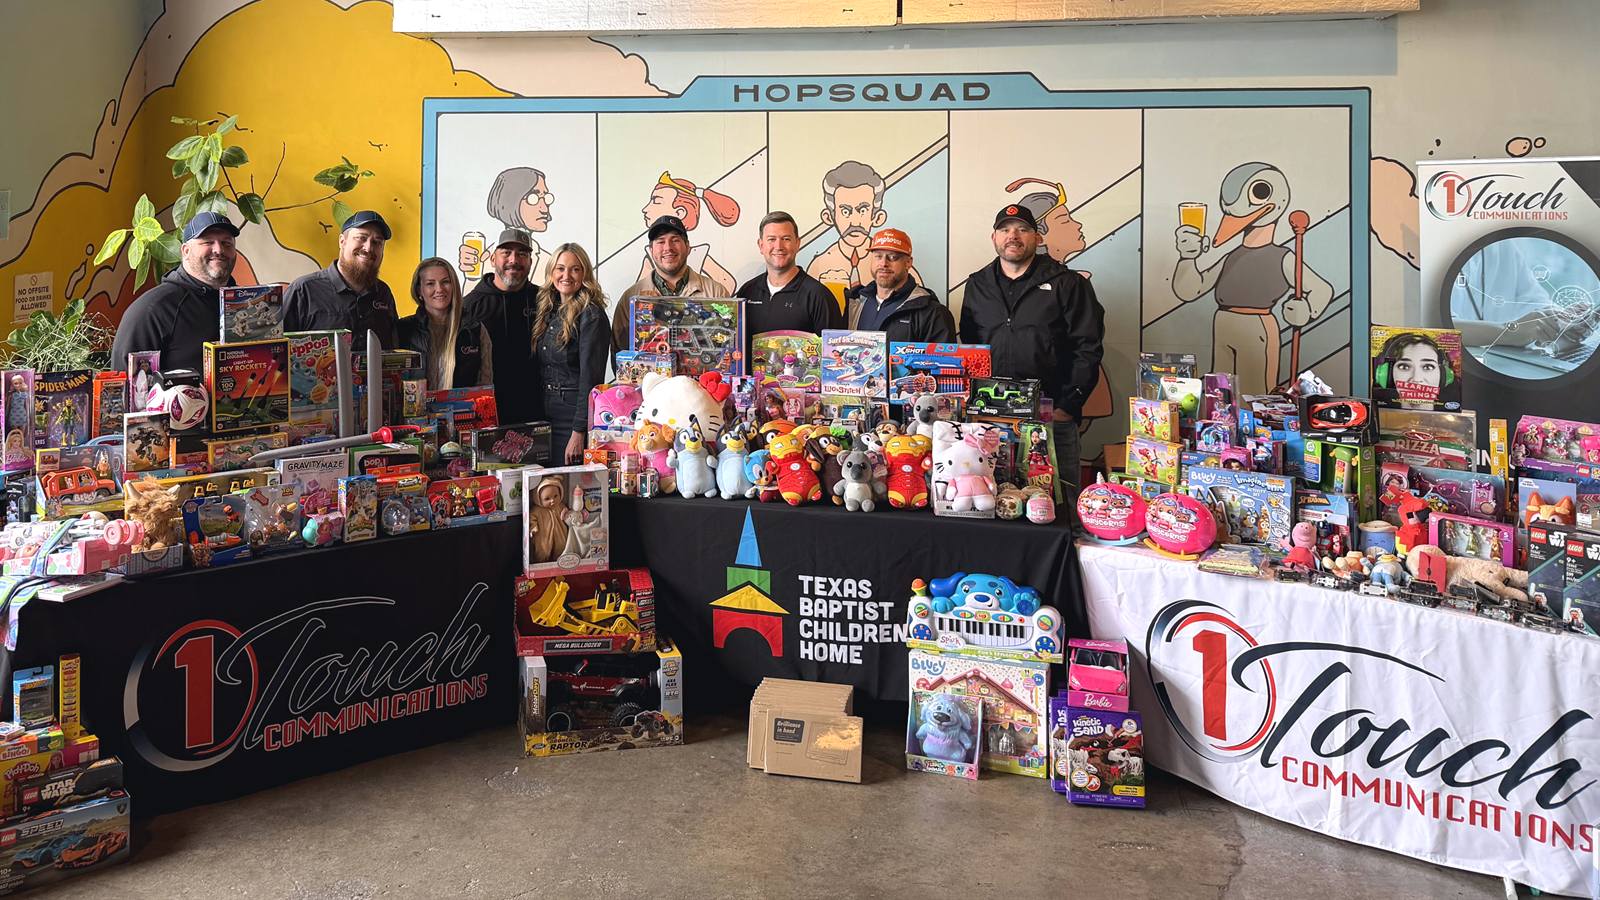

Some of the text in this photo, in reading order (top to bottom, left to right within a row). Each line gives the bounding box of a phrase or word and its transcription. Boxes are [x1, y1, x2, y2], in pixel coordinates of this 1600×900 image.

[733, 82, 991, 102] HOPSQUAD
[1443, 174, 1568, 217] 1 Touch
[1473, 211, 1568, 221] COMMUNICATIONS
[28, 286, 49, 294] OFFSITE
[237, 289, 257, 299] Disney
[20, 301, 47, 311] ALLOWED
[235, 362, 267, 371] ROCKETS
[34, 374, 89, 392] SPIDER-MAN
[1396, 381, 1440, 394] HEARING
[1400, 391, 1437, 399] THINGS
[982, 407, 998, 415] Jeep
[1394, 439, 1440, 454] PIZZA
[287, 460, 344, 471] GRAVITY MAZE
[1531, 532, 1546, 540] LEGO
[1567, 545, 1583, 554] LEGO
[798, 574, 873, 599] TEXAS
[799, 597, 894, 621] BAPTIST
[799, 619, 908, 643] CHILDREN
[800, 640, 863, 665] HOME
[174, 582, 490, 750] 1 Touch
[911, 658, 946, 676] BLUEY
[1084, 693, 1113, 708] Barbie
[263, 673, 488, 752] COMMUNICATIONS
[1192, 629, 1600, 810] 1 Touch
[776, 720, 801, 729] Brilliance
[1072, 717, 1102, 727] Kinetic
[550, 742, 588, 751] RAPTOR
[45, 778, 77, 792] STAR
[24, 786, 76, 800] LEGO WARS
[1281, 756, 1595, 853] COMMUNICATIONS
[21, 819, 64, 837] SPEED
[0, 833, 16, 841] LEGO
